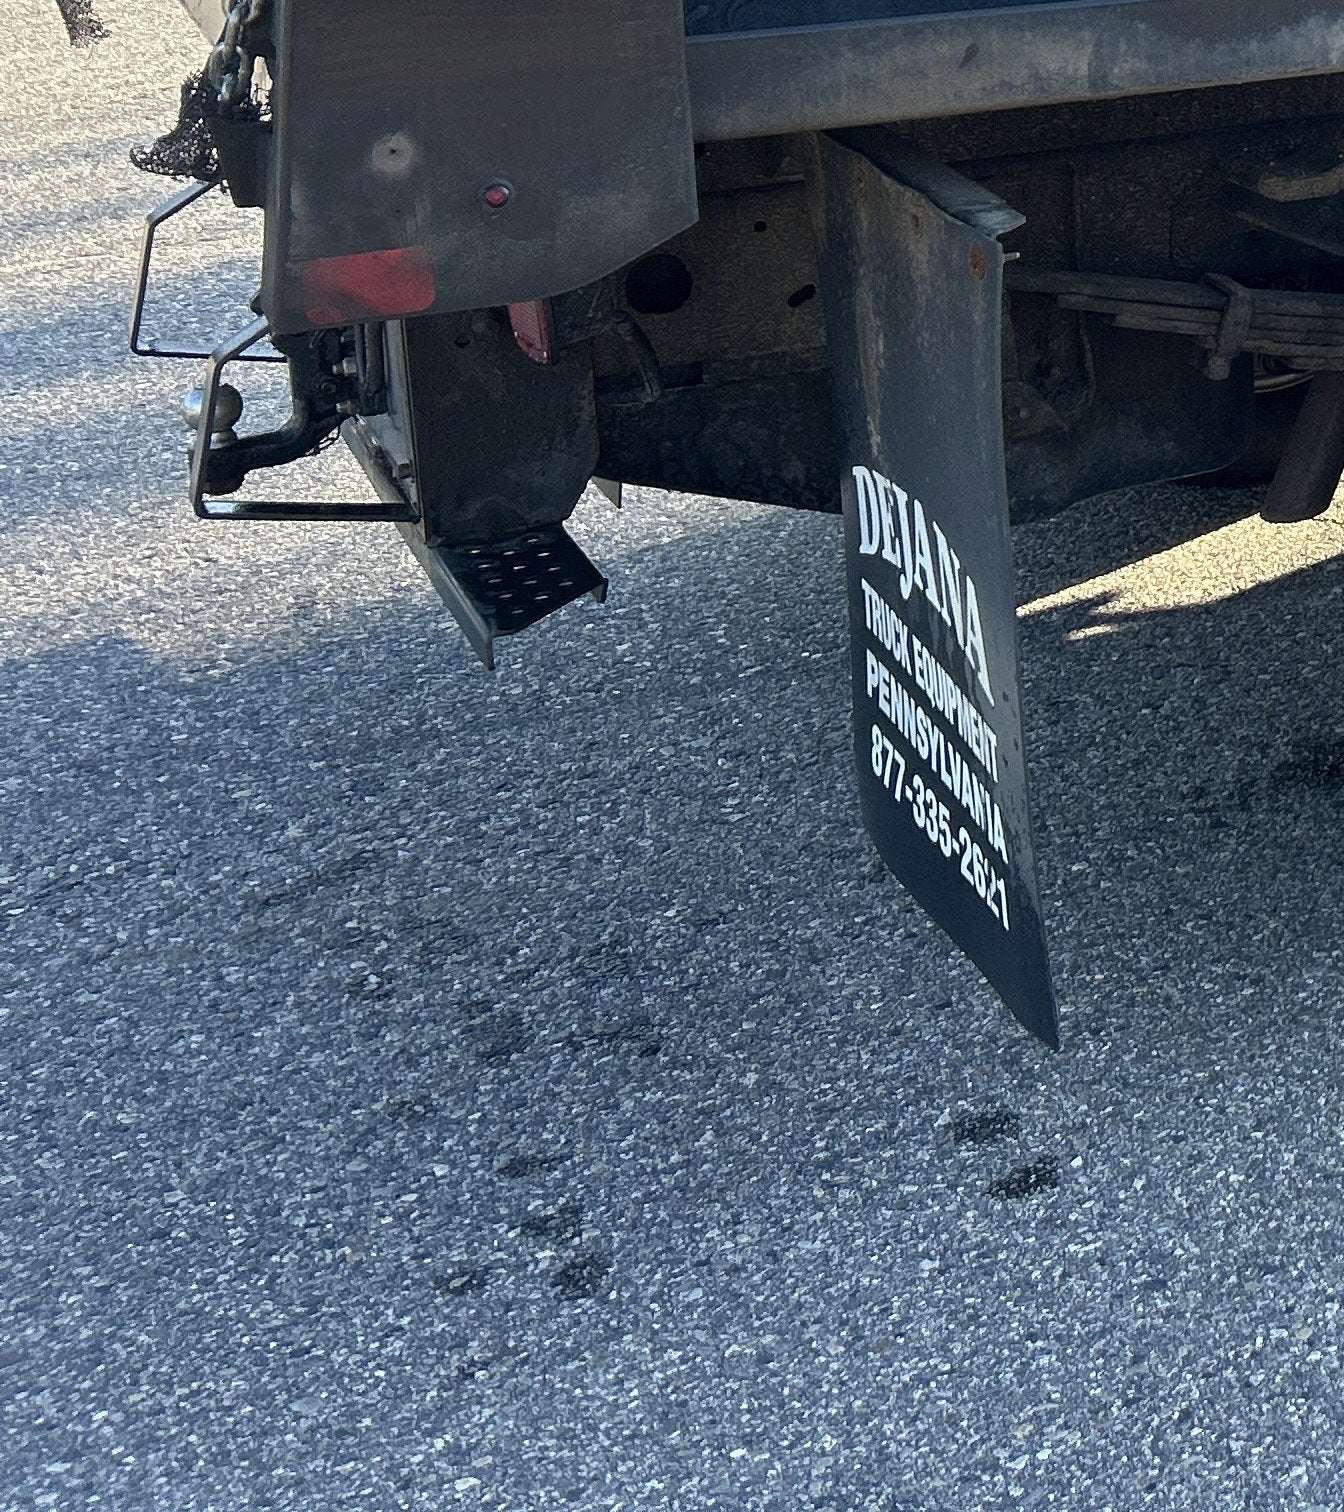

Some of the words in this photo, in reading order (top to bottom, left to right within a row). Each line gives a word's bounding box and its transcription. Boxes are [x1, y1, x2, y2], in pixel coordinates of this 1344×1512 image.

[852, 465, 996, 707] DEJANA
[861, 579, 912, 676] TRUCK
[912, 633, 999, 783] EQUIPMENT
[866, 648, 1009, 864] PENNSYLVANIA
[870, 724, 1010, 932] 877-335-2621
